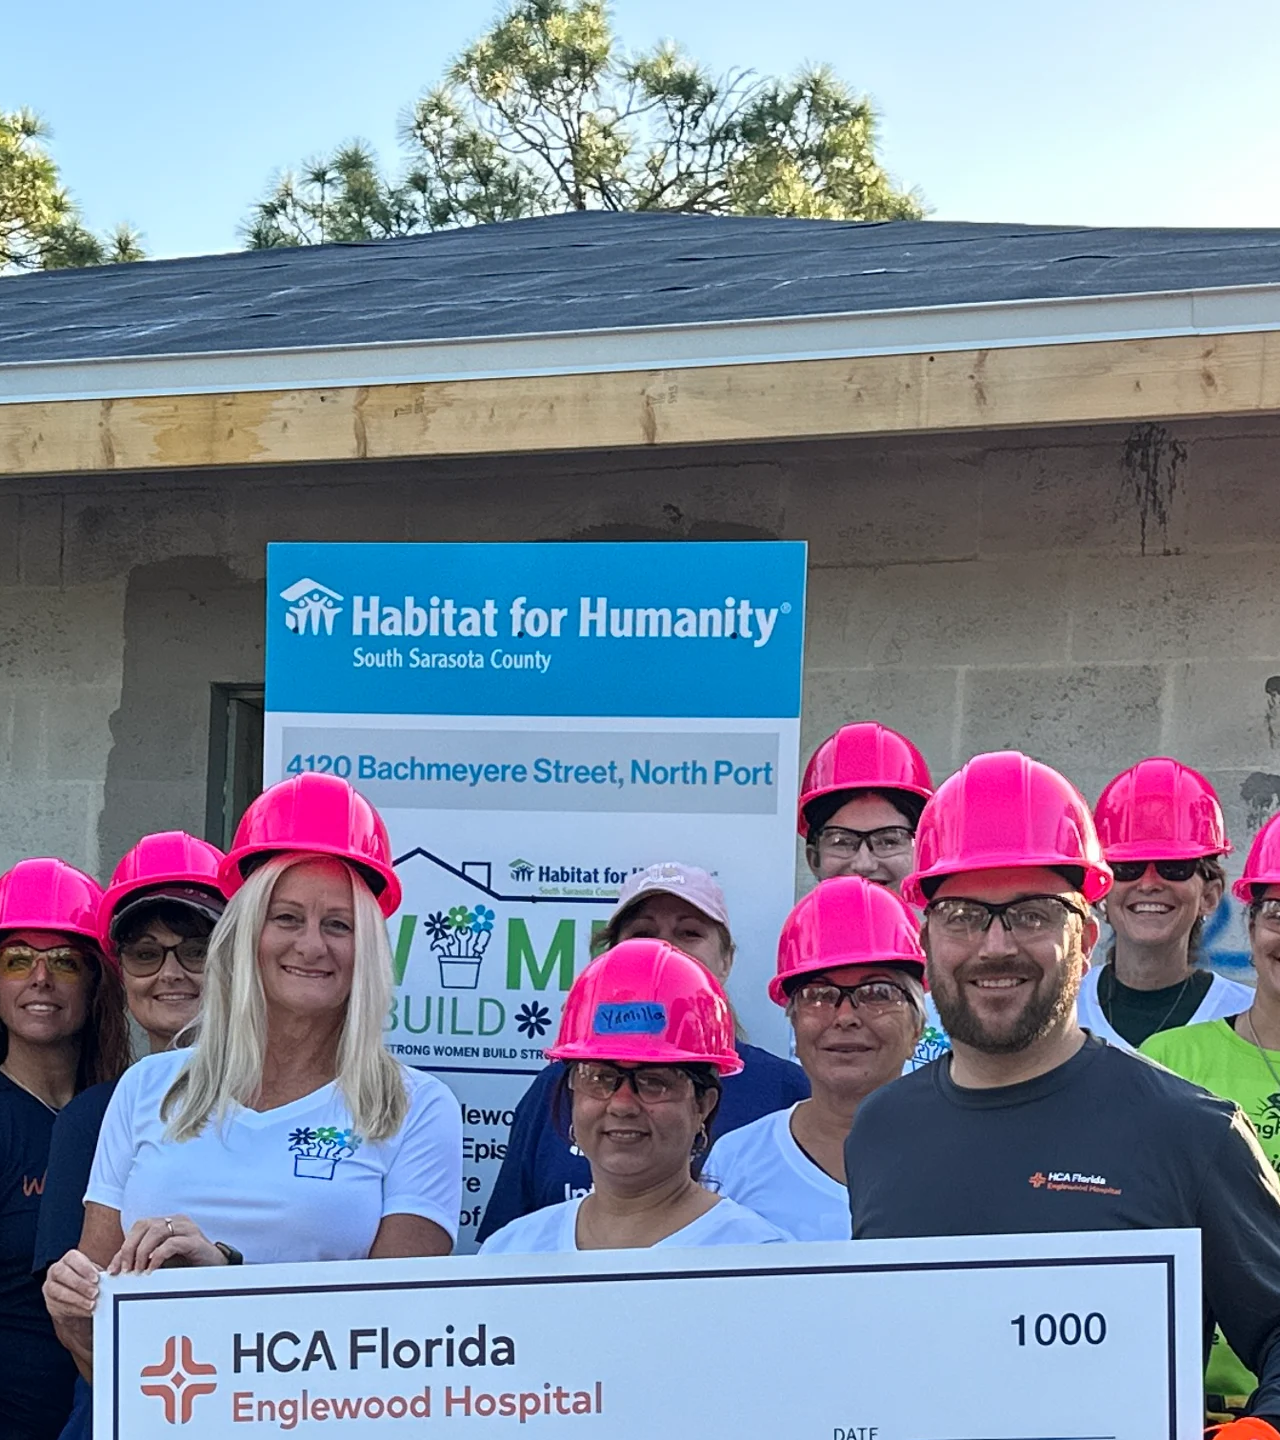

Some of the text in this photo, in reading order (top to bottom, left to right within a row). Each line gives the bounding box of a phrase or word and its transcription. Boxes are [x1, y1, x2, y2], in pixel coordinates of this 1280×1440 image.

[352, 596, 778, 648] Habitat for Humanity
[353, 647, 552, 673] South Sarasota County
[286, 754, 773, 790] 4120 Bachmeyere Street, North Port
[539, 866, 599, 884] Habitat
[604, 867, 628, 884] for
[539, 886, 559, 896] South
[562, 887, 594, 897] Sarasota
[433, 1046, 479, 1058] WOMEN
[483, 1048, 517, 1059] BUILD
[1048, 1172, 1106, 1185] HCA Florida
[1010, 1312, 1107, 1346] 1000
[233, 1323, 516, 1373] HCA Florida
[233, 1381, 603, 1430] Englewood Hospital
